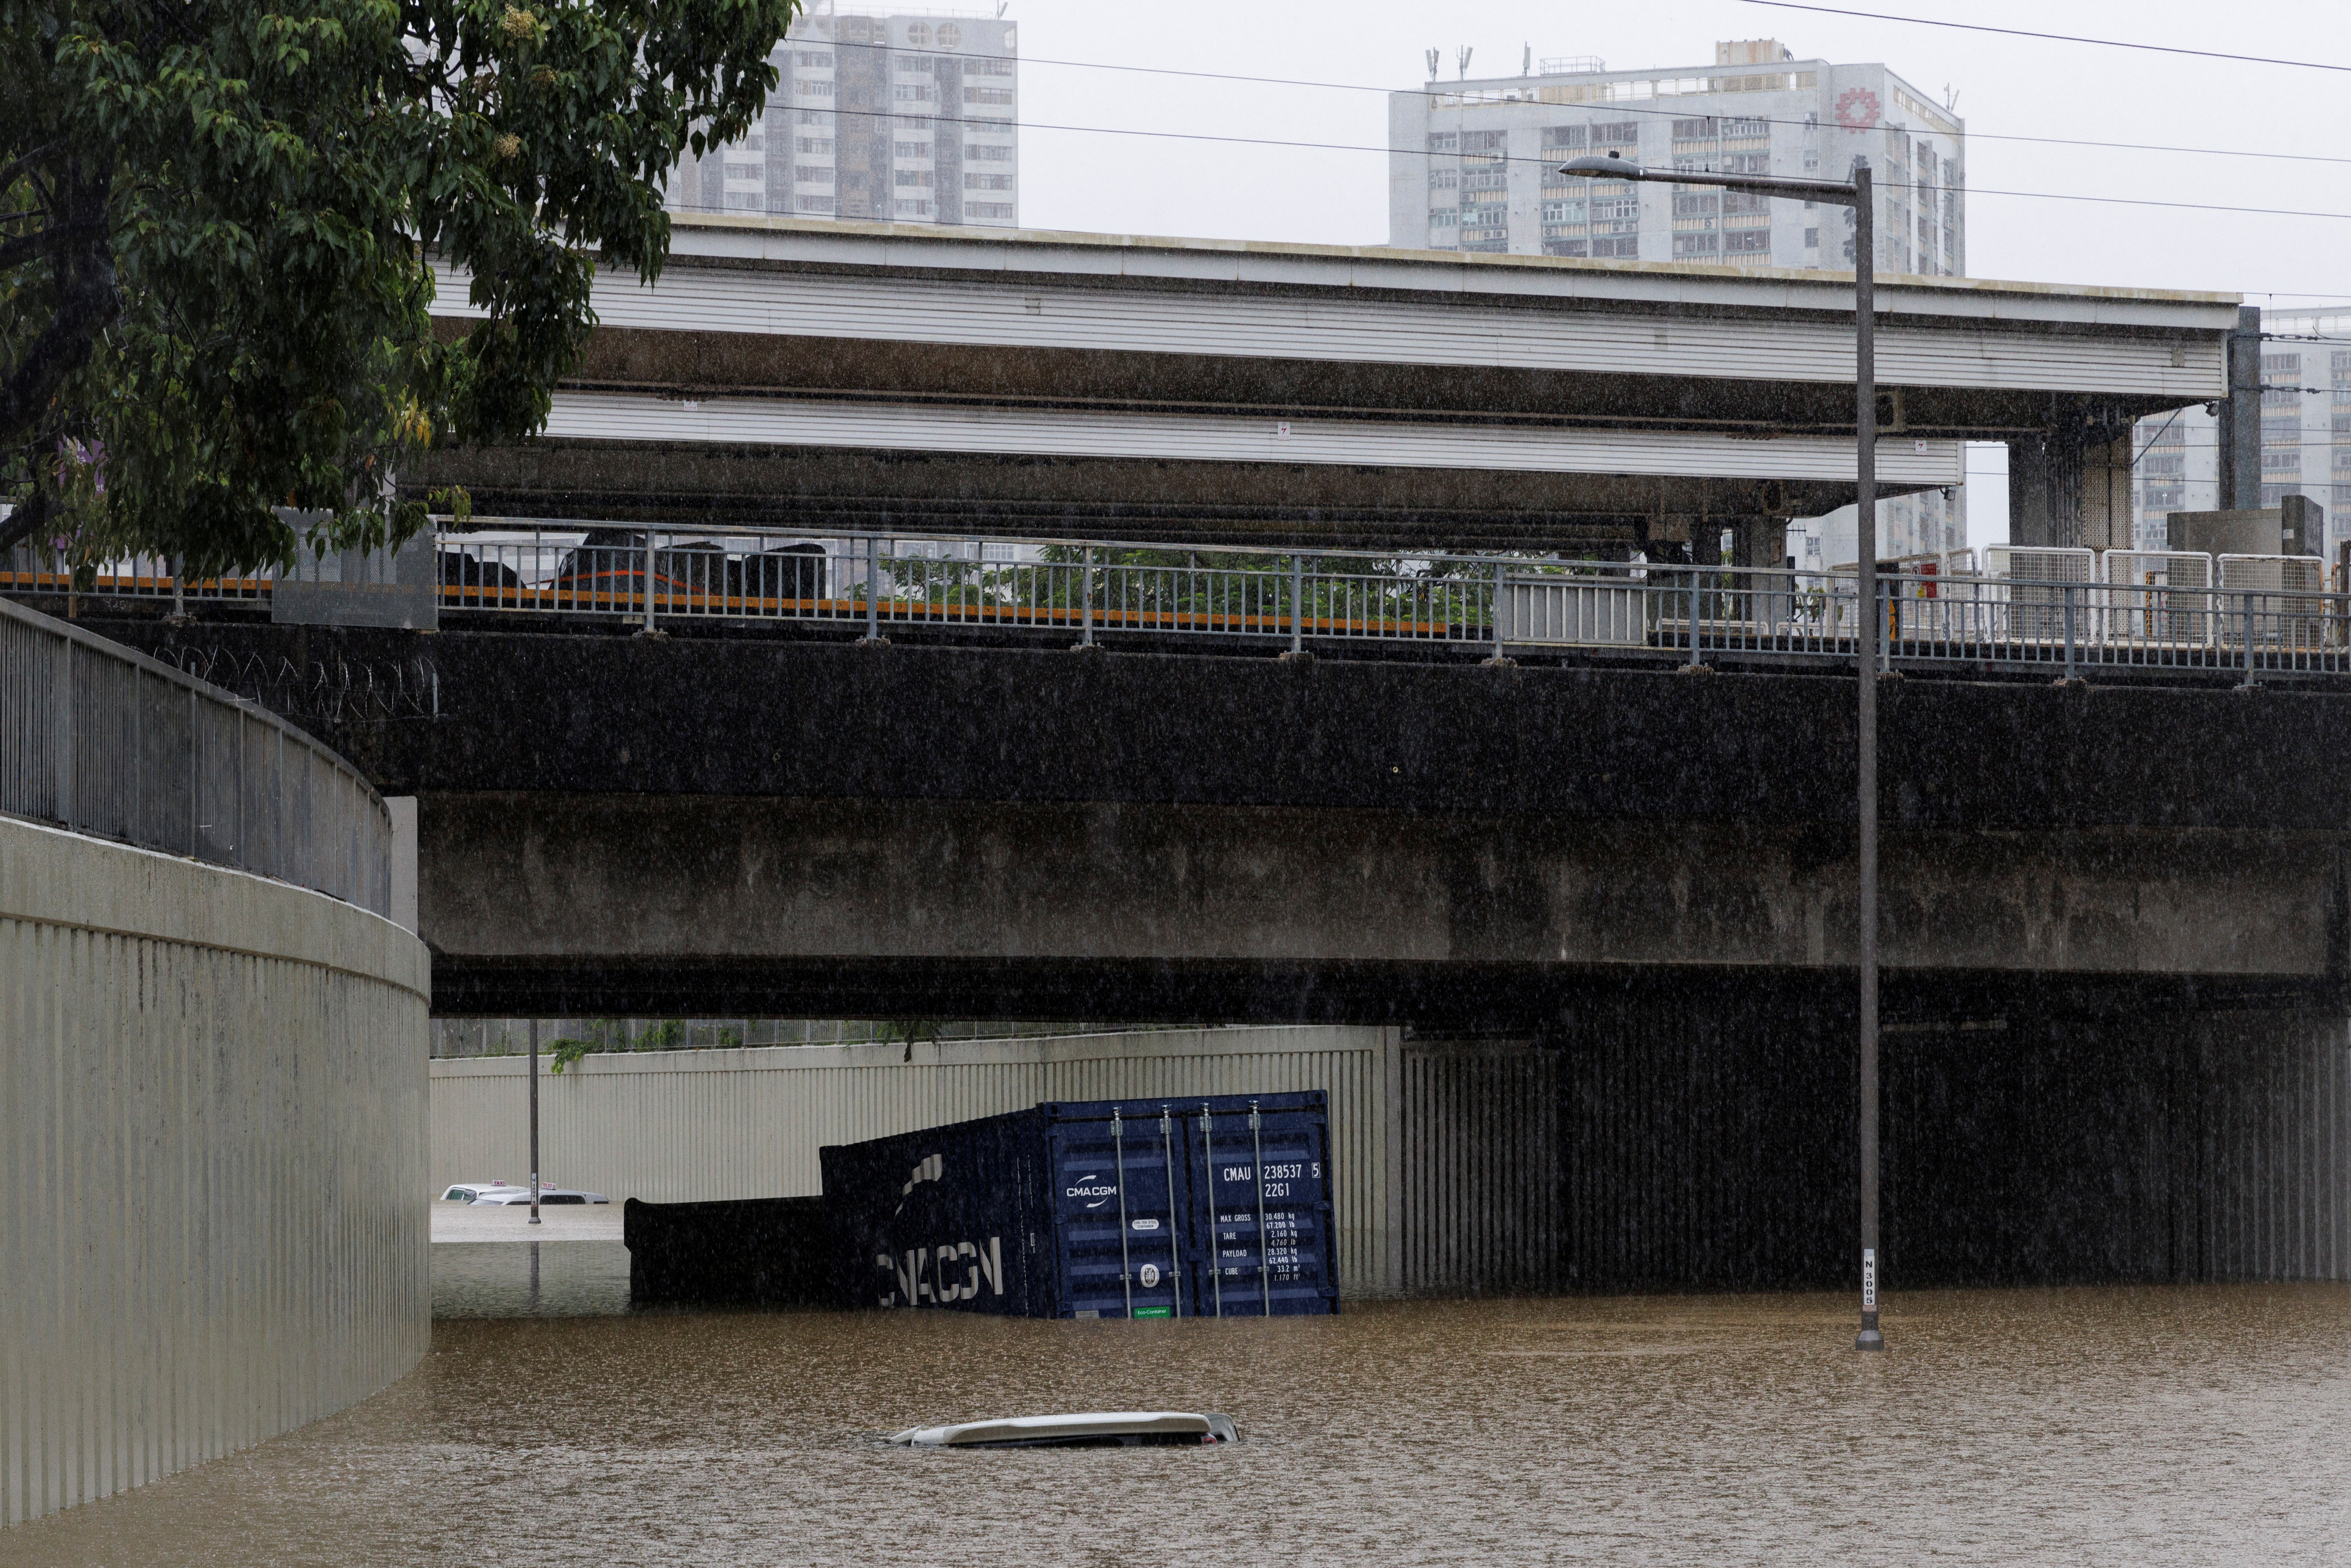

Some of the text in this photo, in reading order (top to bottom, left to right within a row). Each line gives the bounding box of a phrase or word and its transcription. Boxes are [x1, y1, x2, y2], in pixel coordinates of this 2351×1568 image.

[1224, 1166, 1251, 1181] CMAU
[1264, 1164, 1302, 1179] 238537
[1265, 1183, 1289, 1197] 22G1
[1265, 1212, 1285, 1221] 30.480
[1288, 1212, 1295, 1221] kg
[1271, 1230, 1287, 1238] 2.160
[1290, 1230, 1297, 1238] kg
[1223, 1247, 1297, 1257] PAYLOAD 28.320 kg
